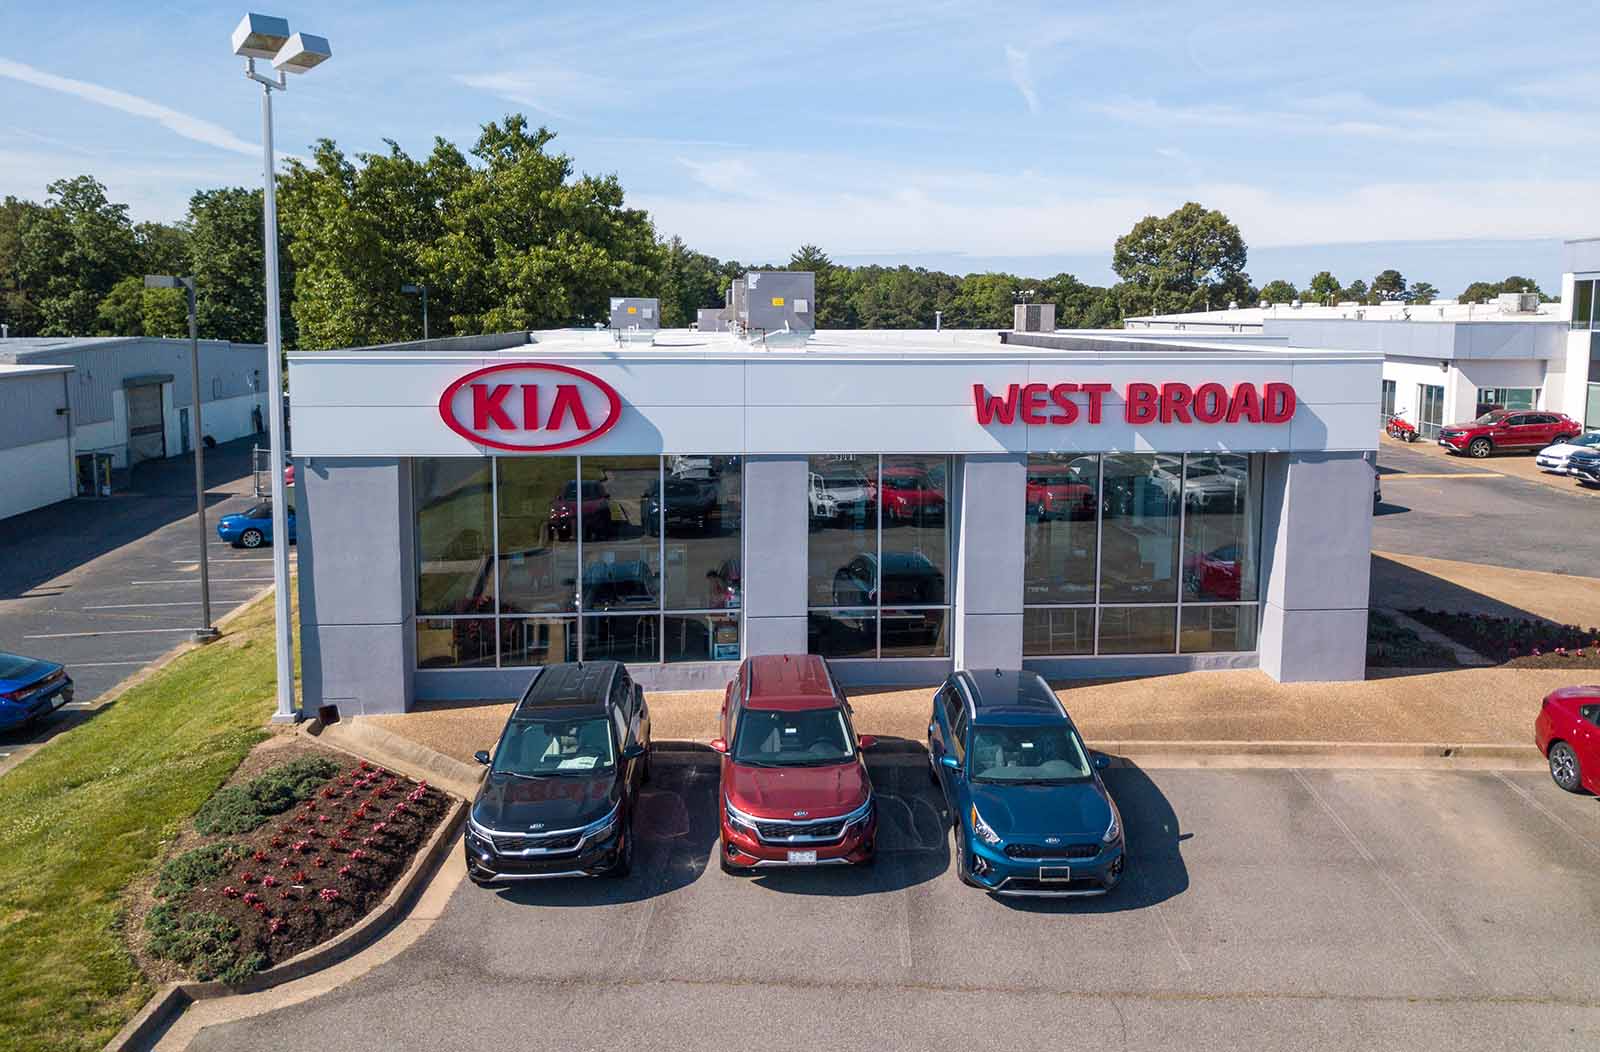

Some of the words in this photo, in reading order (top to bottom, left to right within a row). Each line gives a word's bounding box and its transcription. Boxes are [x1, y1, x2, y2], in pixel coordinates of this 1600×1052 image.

[470, 383, 593, 431] KIA
[973, 383, 1112, 425] WEST
[1124, 382, 1297, 425] BROAD
